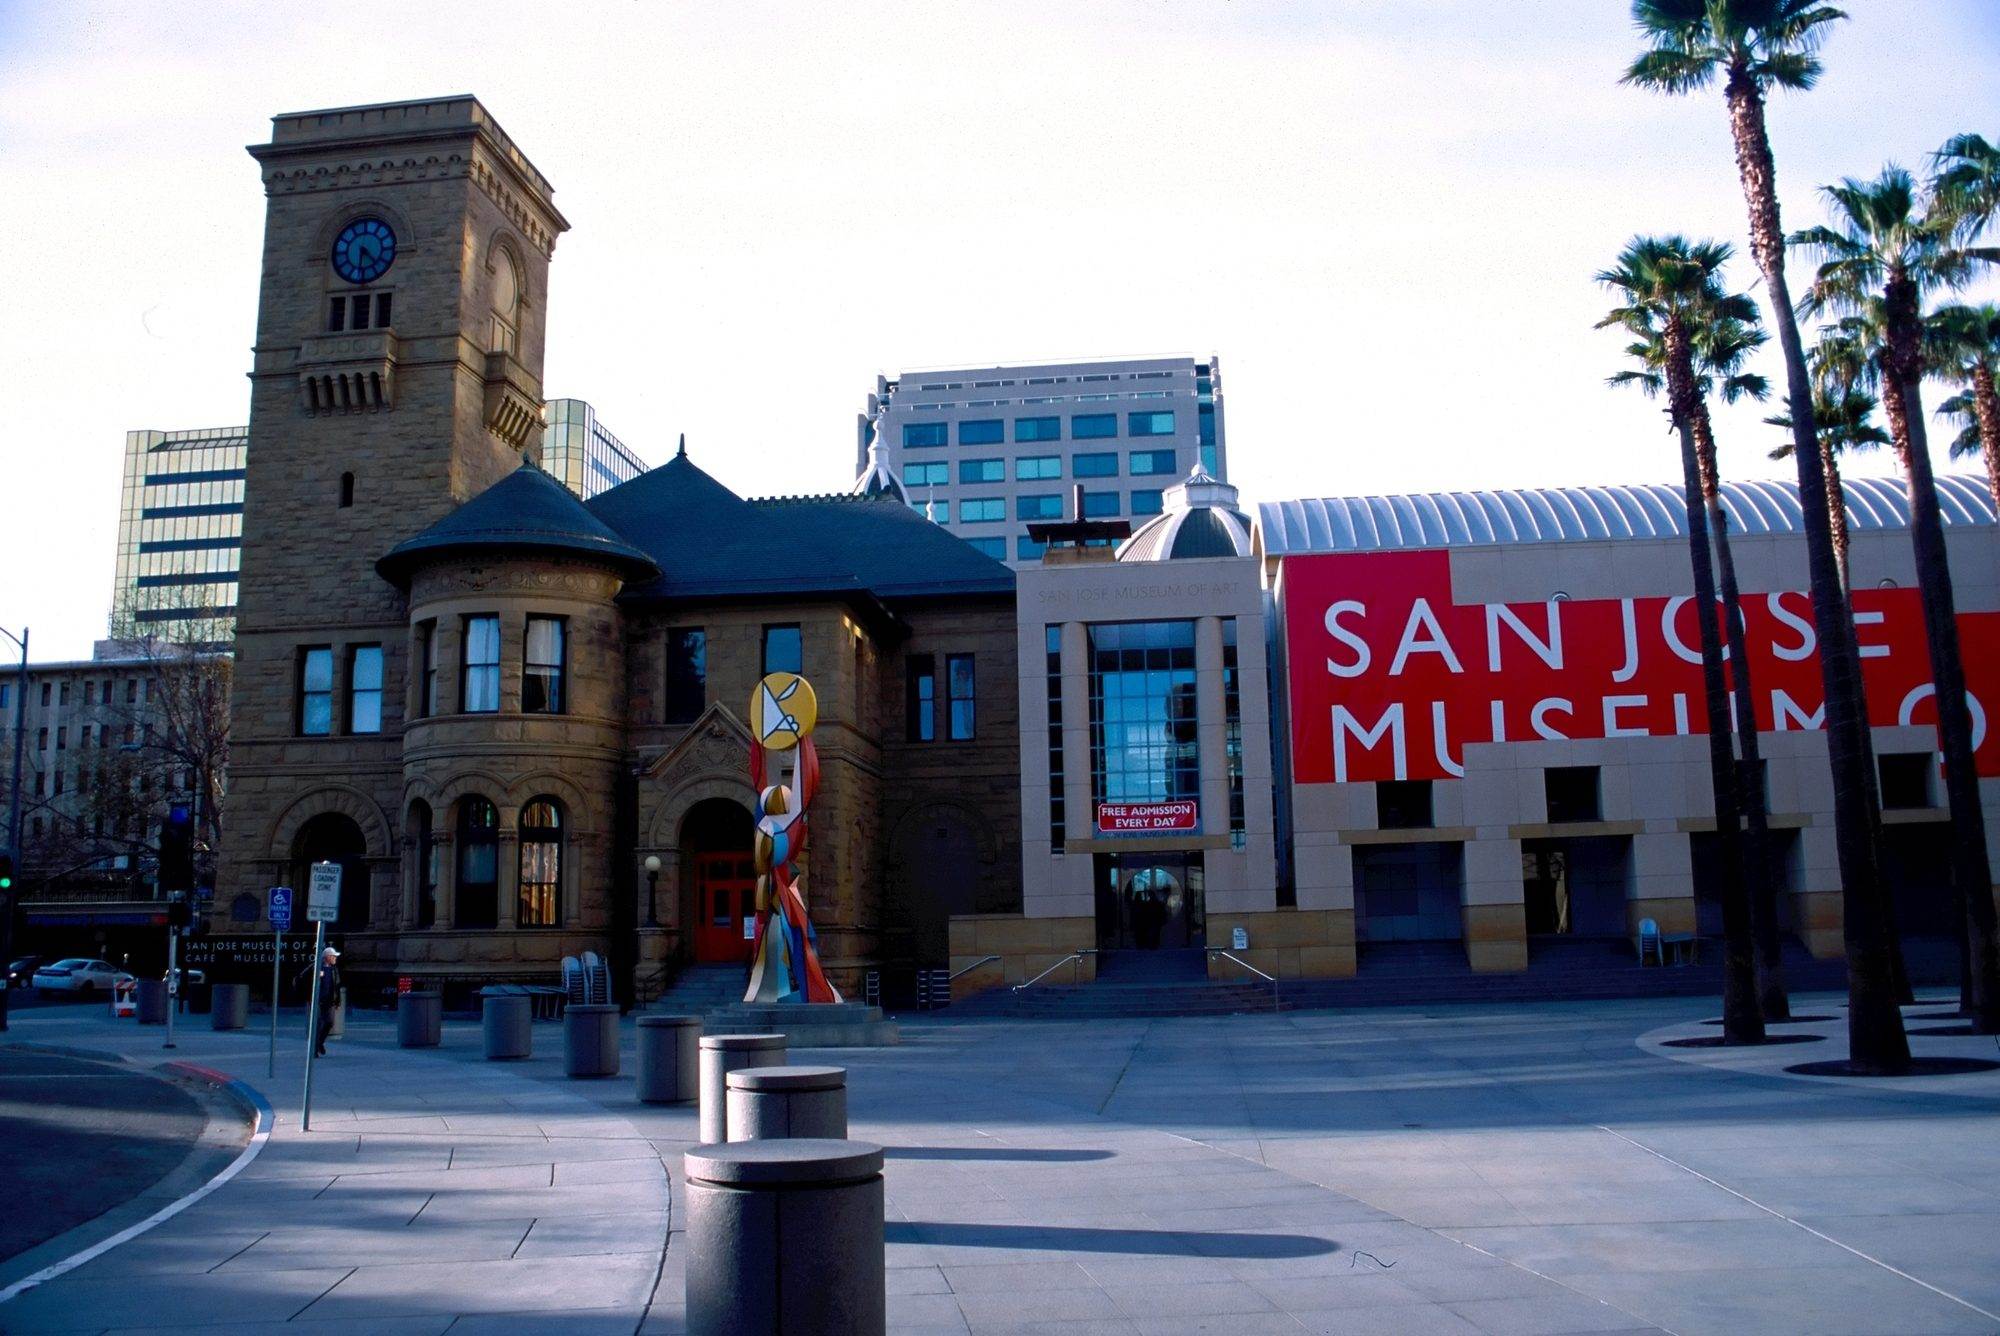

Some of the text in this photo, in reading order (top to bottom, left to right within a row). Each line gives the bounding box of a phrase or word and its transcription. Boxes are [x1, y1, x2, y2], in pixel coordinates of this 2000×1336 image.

[1038, 582, 1240, 603] SAN JOSE MUSEUM OF ART
[1324, 597, 1564, 678] SAN
[1101, 805, 1191, 817] FREE ADMISSION
[1115, 817, 1176, 828] EVERY DAY
[314, 874, 337, 883] LOADING
[317, 883, 332, 891] ZONE
[185, 941, 335, 953] SAN JOSE MUSEUM OF AT
[185, 953, 216, 963] CAFE
[233, 953, 286, 963] MUSEUM
